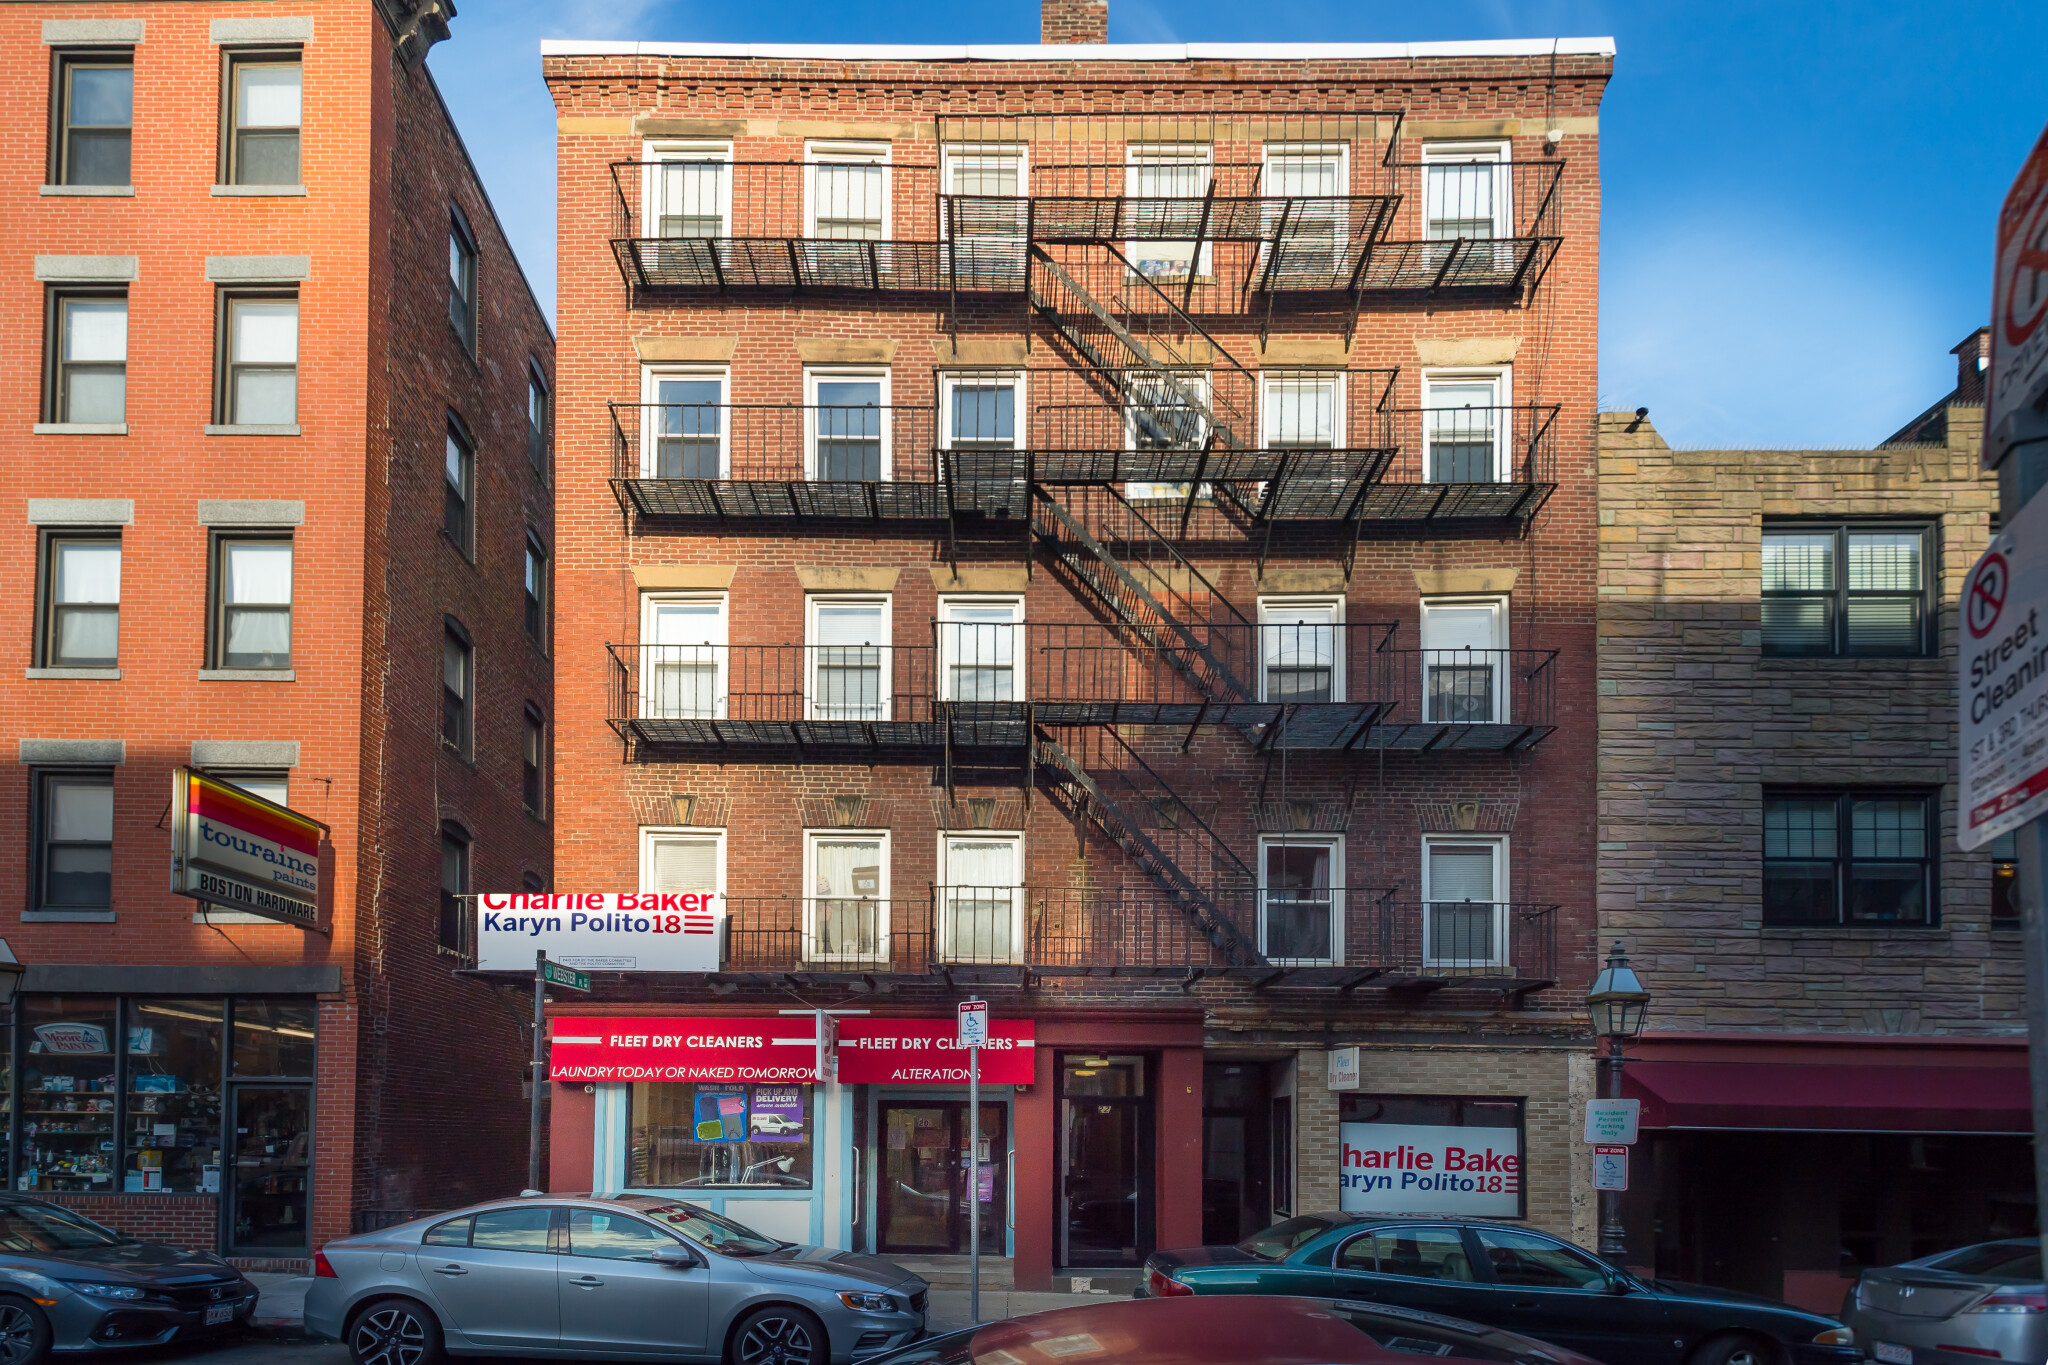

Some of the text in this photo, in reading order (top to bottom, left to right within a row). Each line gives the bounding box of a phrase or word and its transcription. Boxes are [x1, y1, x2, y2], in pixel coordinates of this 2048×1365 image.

[1970, 607, 2039, 689] Street
[200, 822, 317, 876] touraine
[273, 870, 316, 891] paints
[200, 873, 316, 921] BOSTON HARDWARE
[483, 894, 715, 911] Charlie Baker
[484, 912, 561, 937] Karyn
[571, 912, 650, 932] Polito
[553, 966, 576, 985] WEBSTER
[44, 1032, 81, 1042] Moore
[56, 1042, 95, 1050] PAINTS
[610, 1035, 763, 1049] FLEET DRY CLEANERS
[860, 1037, 1013, 1050] FLEET DRY CLEERS
[552, 1066, 615, 1078] LAUNDRY
[617, 1066, 664, 1078] TODAY
[665, 1066, 686, 1078] OR
[688, 1067, 734, 1079] NAKED
[919, 1119, 929, 1127] 20
[1343, 1143, 1518, 1173] harlie Bake
[1401, 1172, 1475, 1192] Polito
